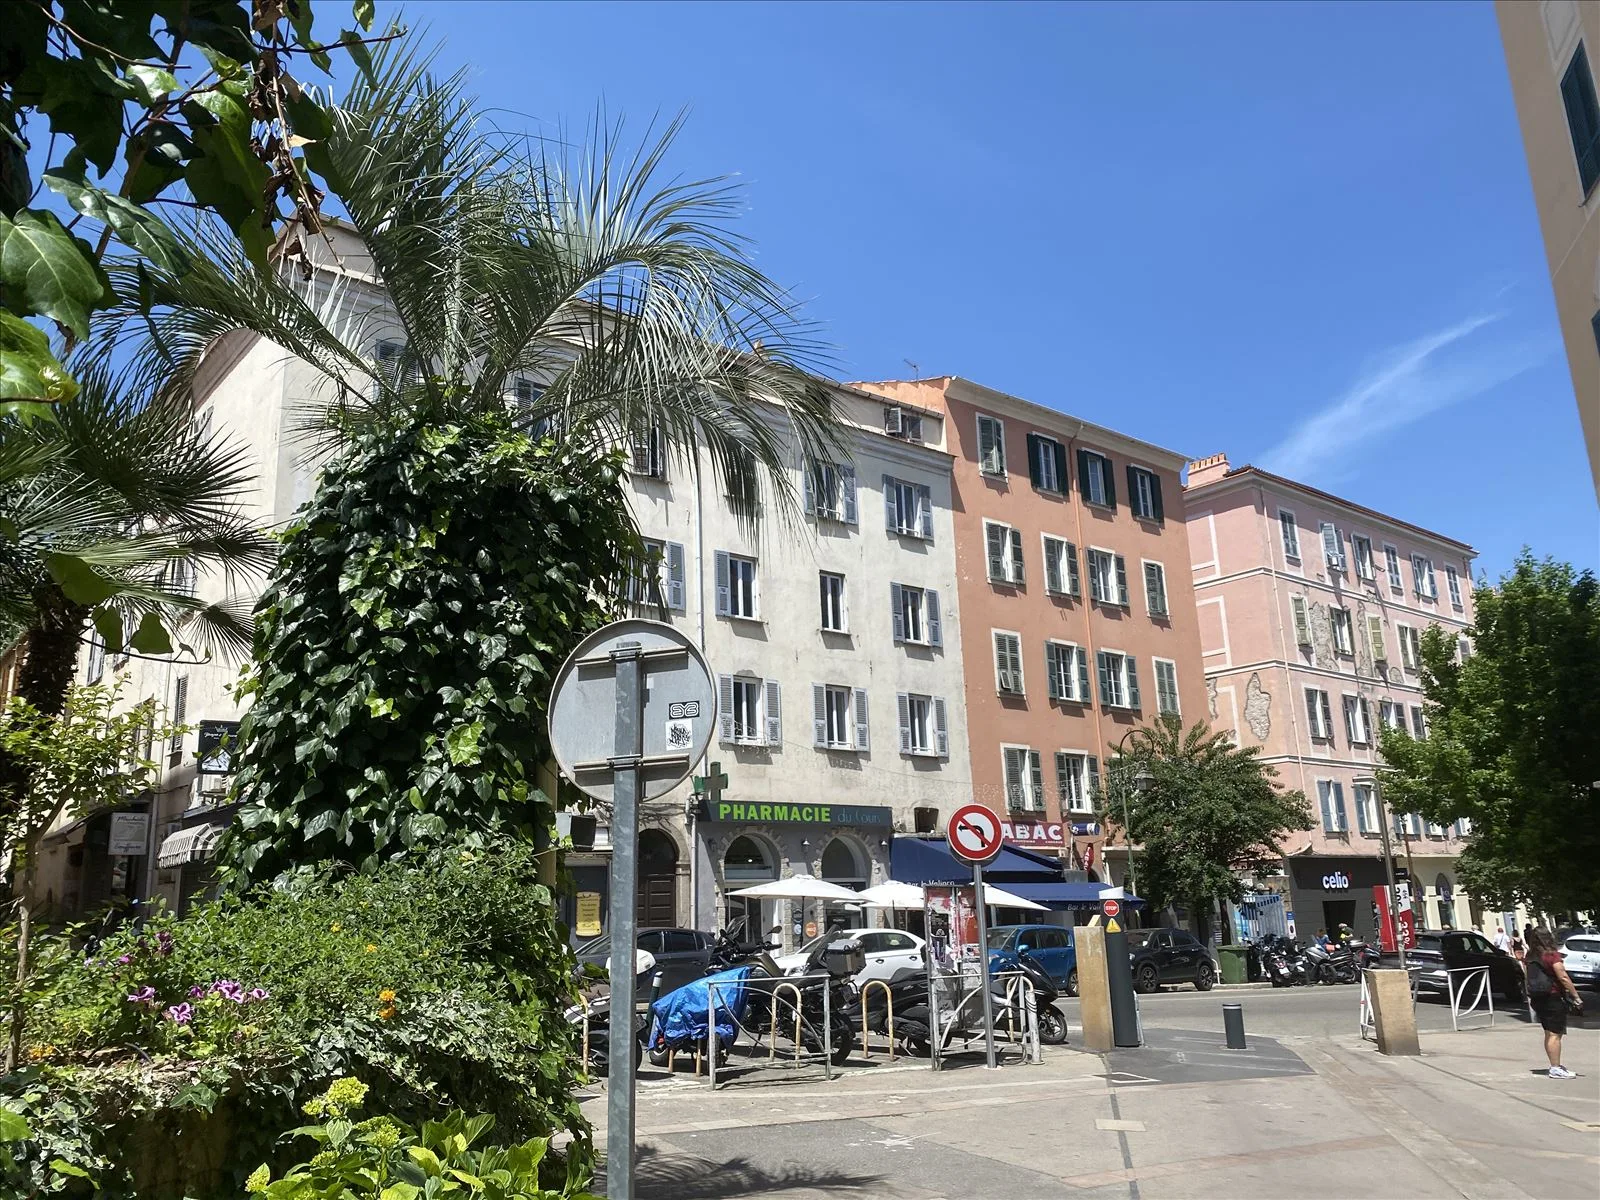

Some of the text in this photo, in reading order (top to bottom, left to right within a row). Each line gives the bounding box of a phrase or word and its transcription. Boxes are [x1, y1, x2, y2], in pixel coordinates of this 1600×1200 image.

[719, 804, 831, 822] PHARMACIE
[838, 808, 852, 823] du
[1001, 823, 1062, 840] ABAC
[1083, 846, 1091, 872] TABAC
[1322, 871, 1349, 889] celio
